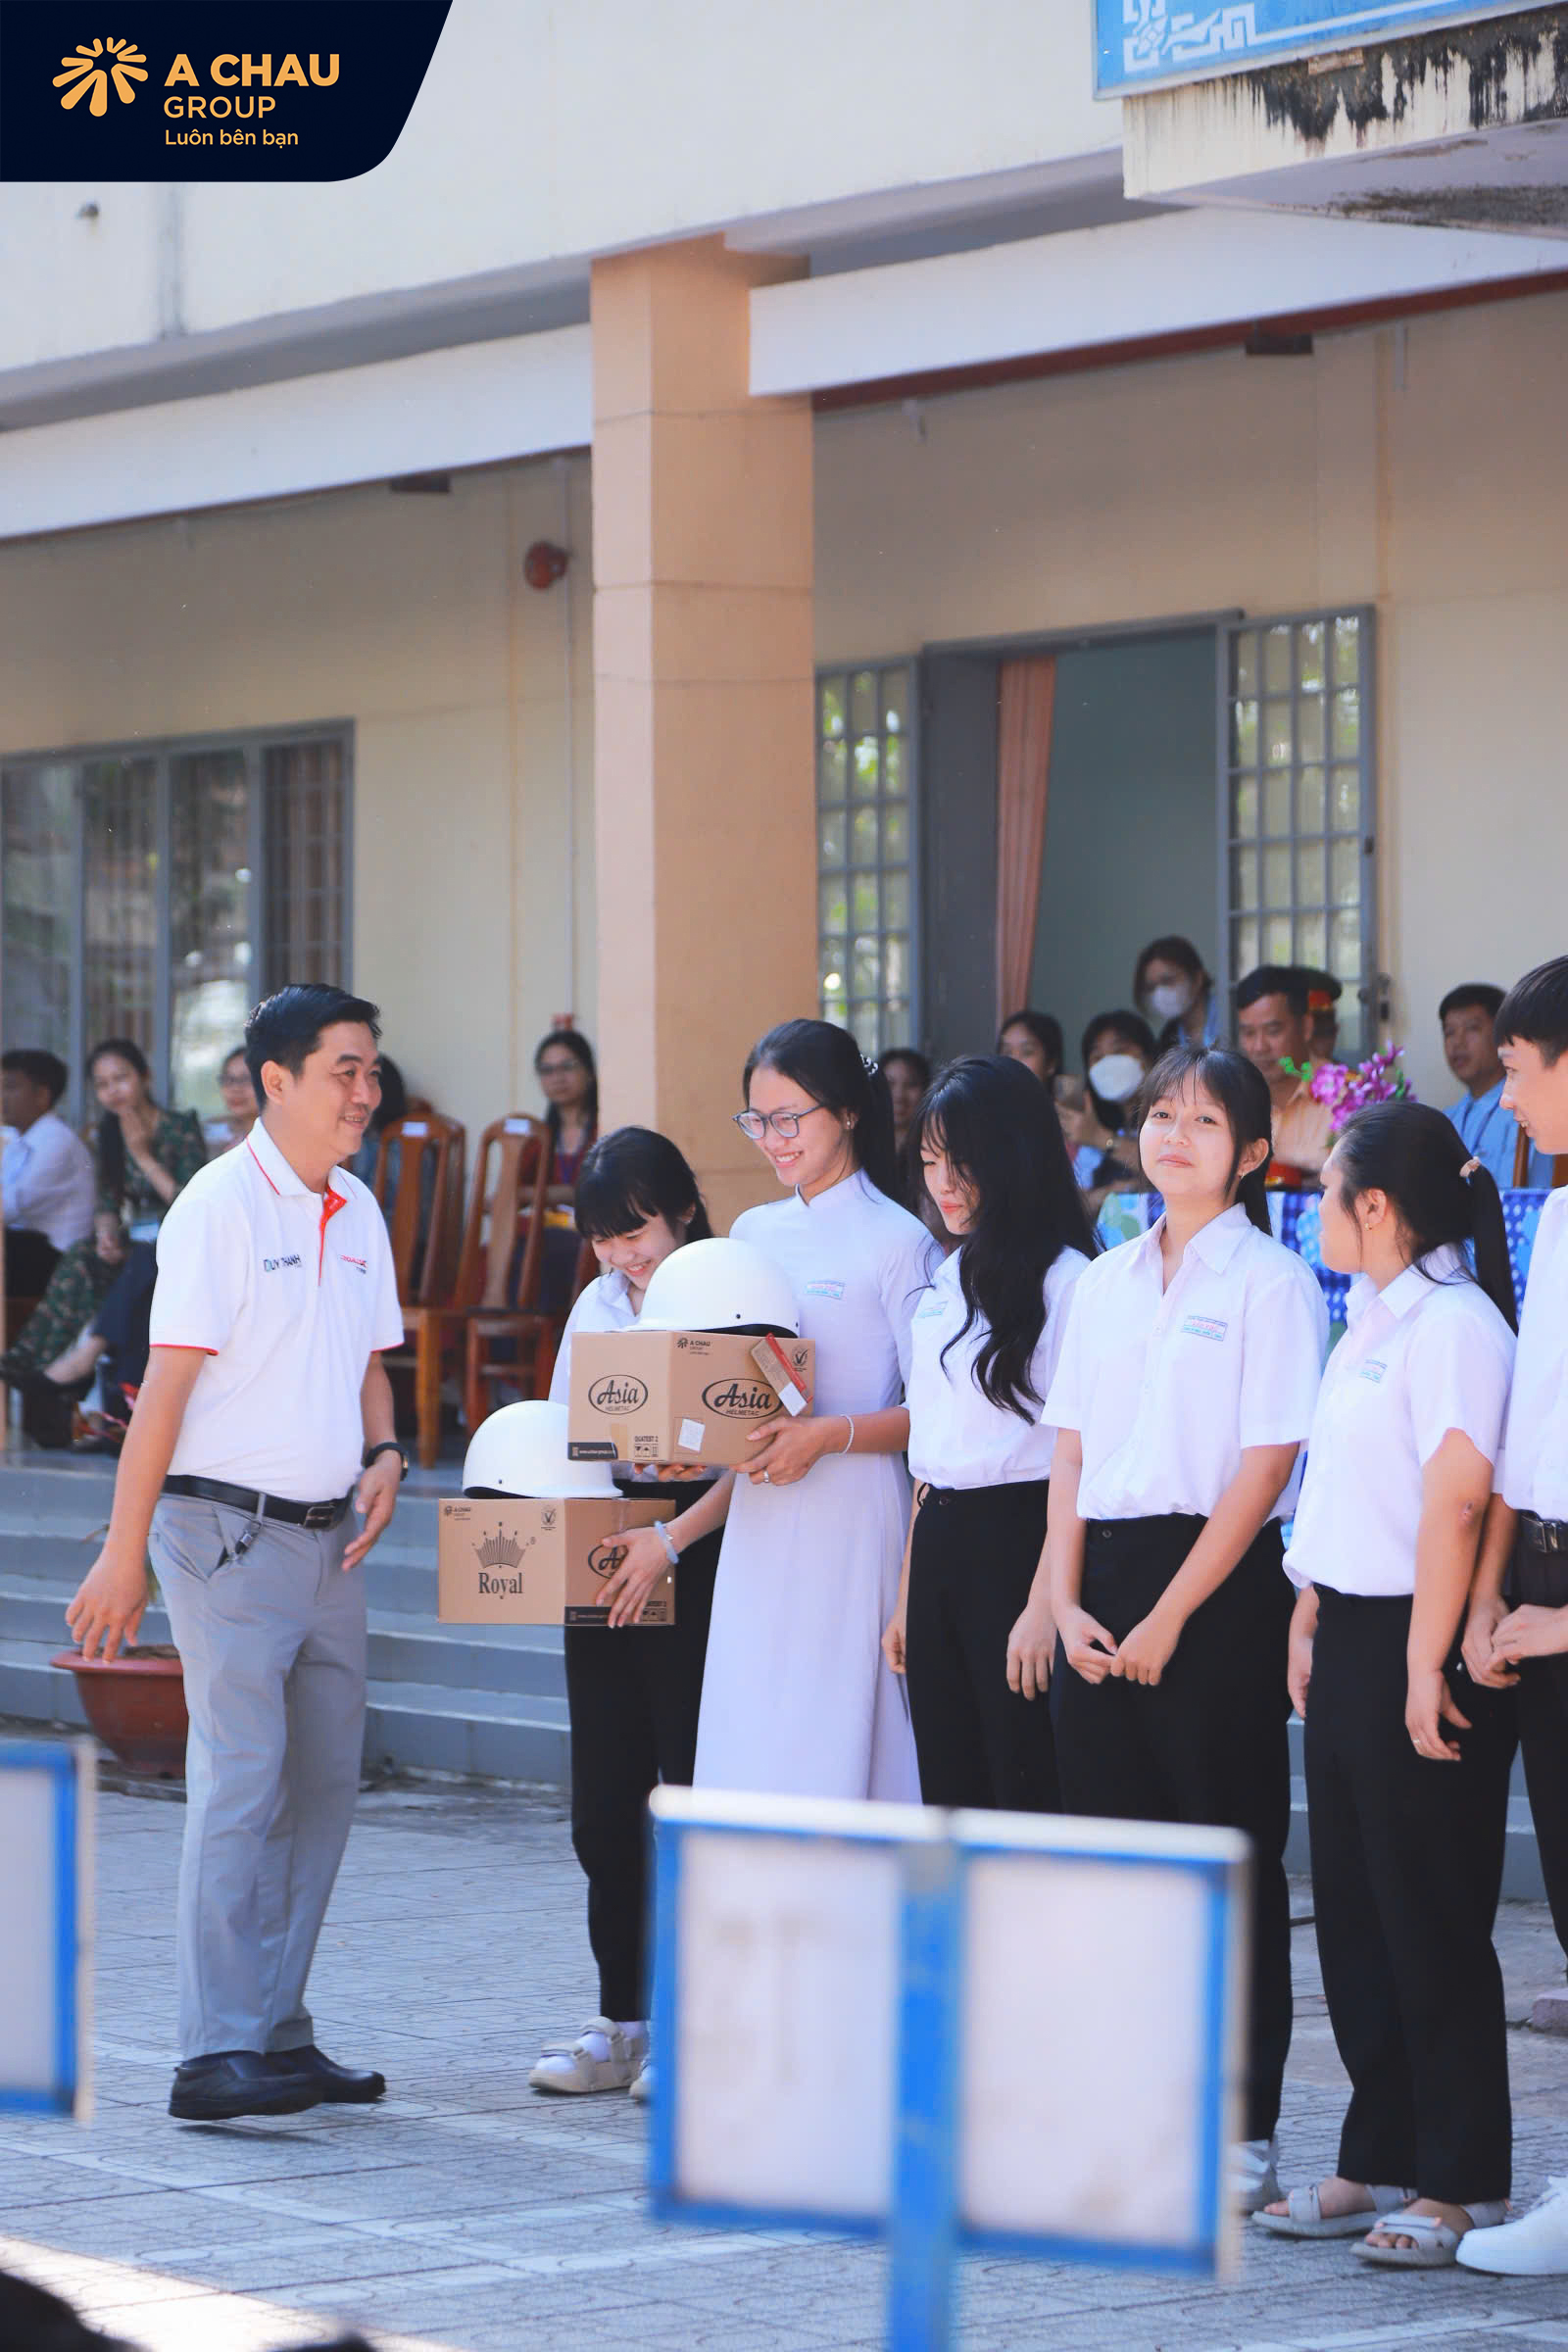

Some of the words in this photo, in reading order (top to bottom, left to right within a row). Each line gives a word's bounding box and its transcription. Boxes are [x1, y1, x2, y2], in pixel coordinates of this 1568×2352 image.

[597, 1379, 638, 1405] Asia
[713, 1383, 772, 1409] Asia
[478, 1572, 522, 1599] Royal
